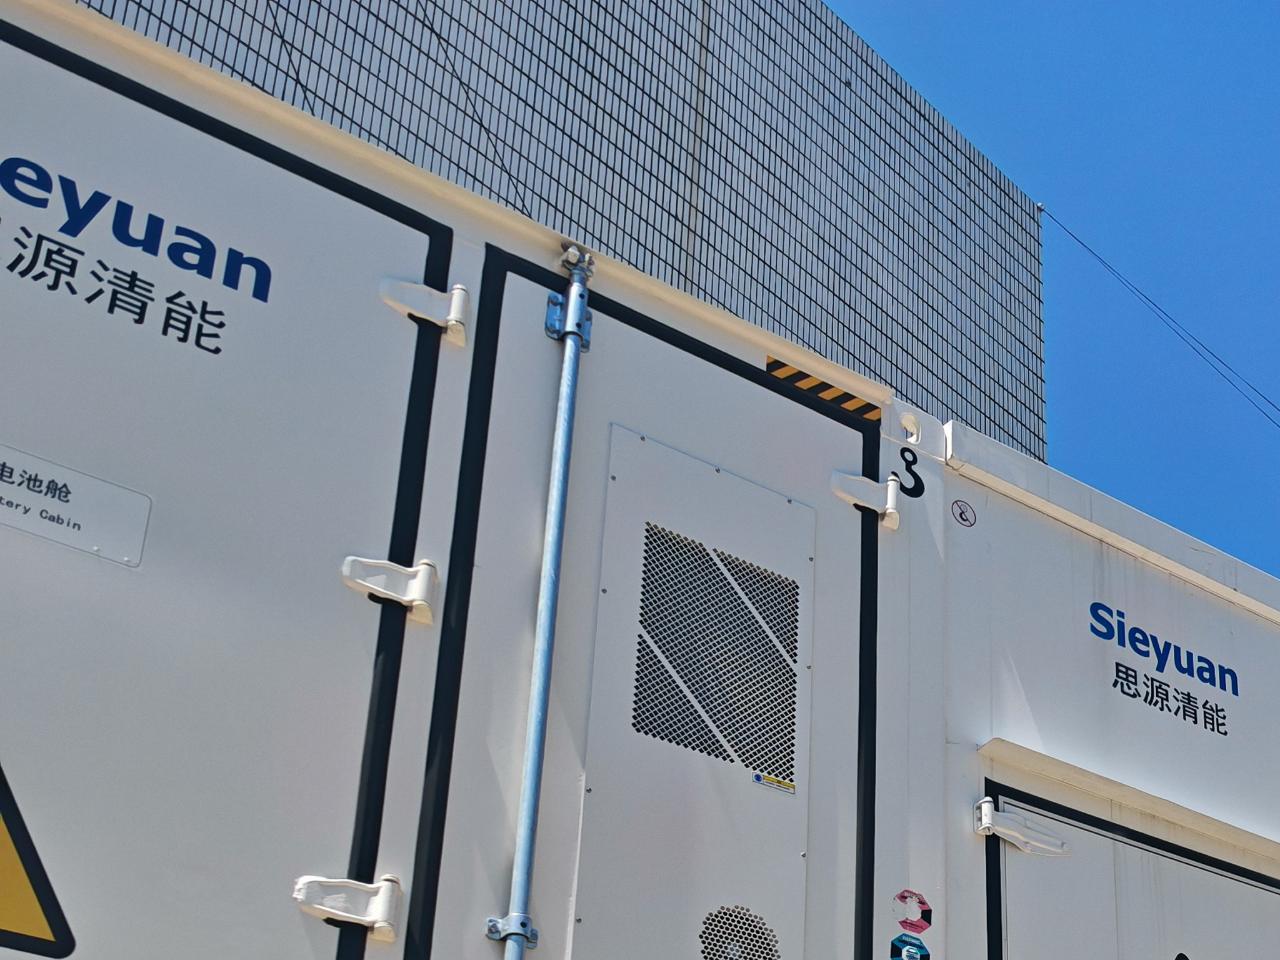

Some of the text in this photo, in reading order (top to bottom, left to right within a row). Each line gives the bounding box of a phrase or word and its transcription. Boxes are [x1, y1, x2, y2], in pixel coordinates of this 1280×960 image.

[0, 157, 272, 304] eyuan
[0, 216, 226, 355] 源清能
[39, 508, 82, 531] Cabin
[1089, 601, 1240, 697] Sieyuan
[1112, 661, 1228, 736] 思源清能
